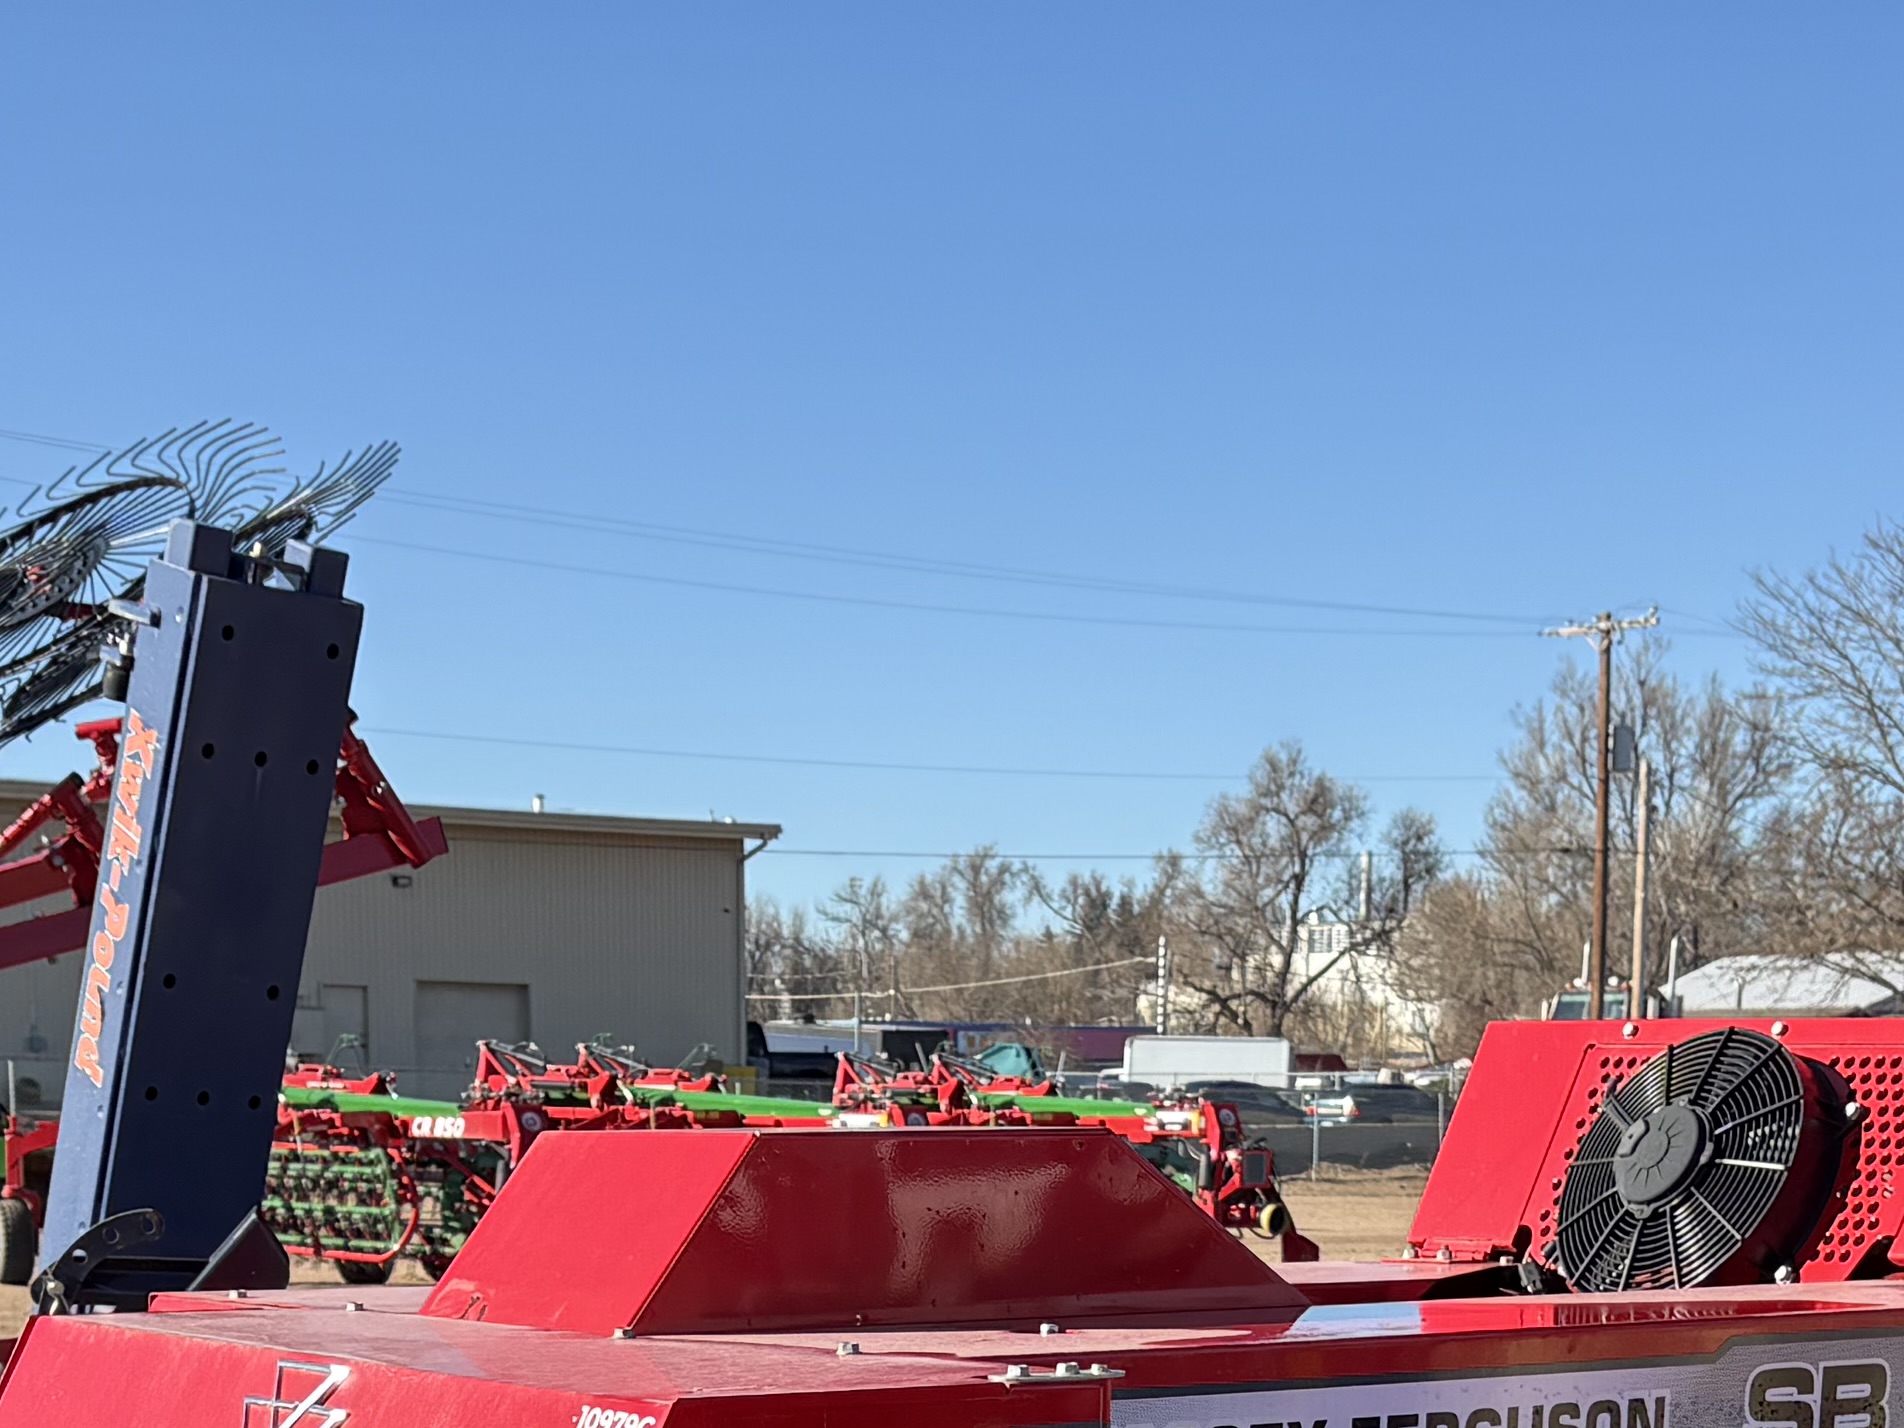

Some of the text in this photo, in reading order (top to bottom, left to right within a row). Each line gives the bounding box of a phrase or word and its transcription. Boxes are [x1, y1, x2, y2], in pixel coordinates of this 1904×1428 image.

[74, 708, 161, 1079] Kwik-Pound
[411, 1116, 466, 1138] CR 850
